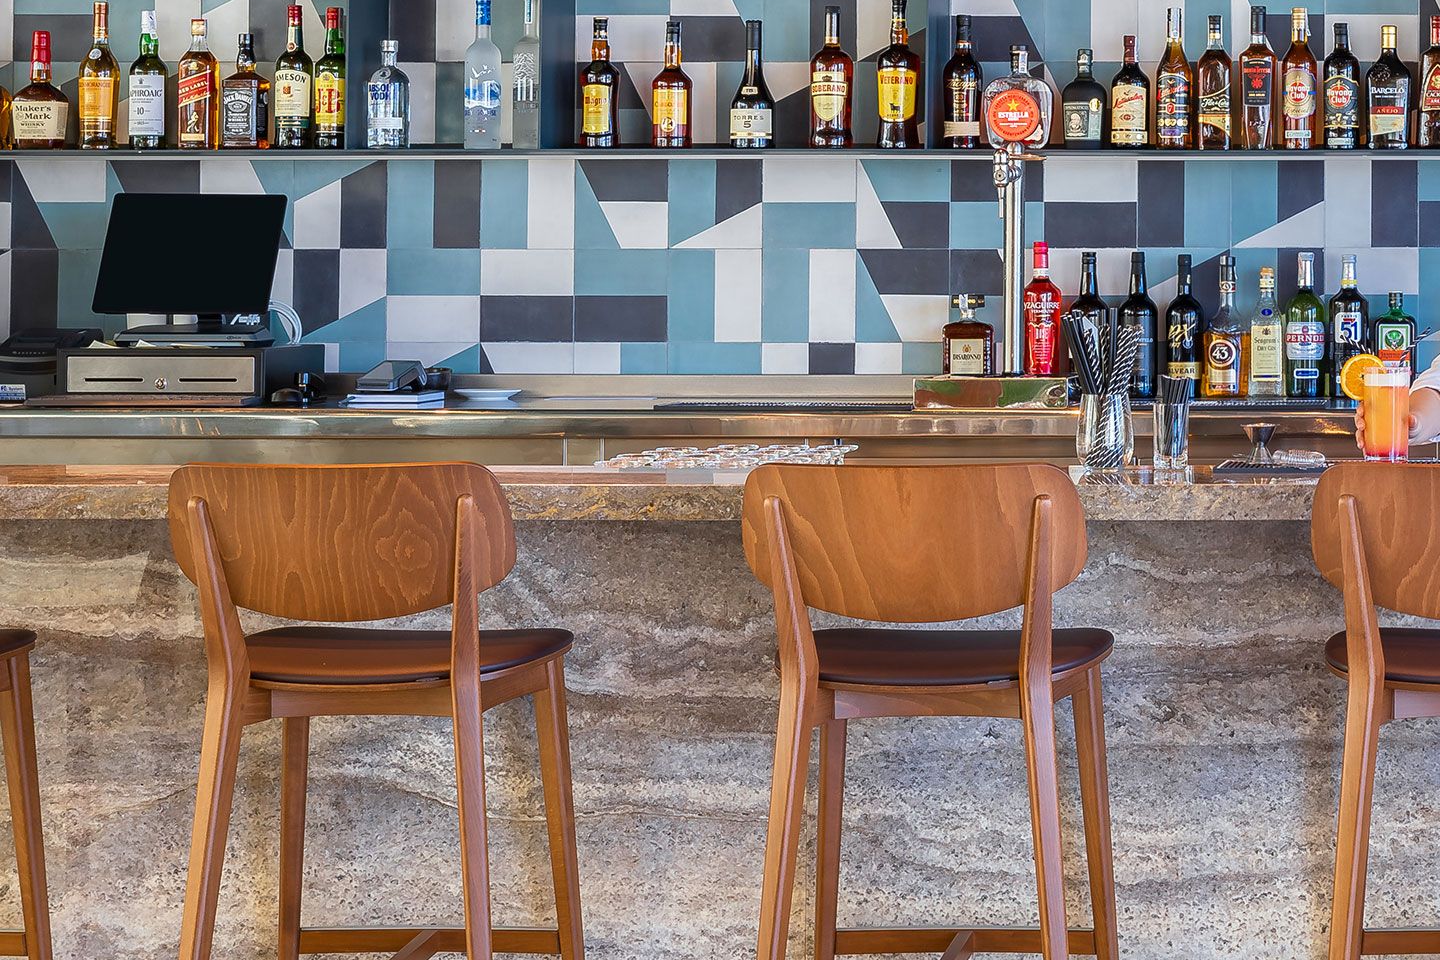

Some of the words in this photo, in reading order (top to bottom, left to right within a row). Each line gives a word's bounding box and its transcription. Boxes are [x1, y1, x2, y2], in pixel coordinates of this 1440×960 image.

[880, 75, 914, 85] VETERANO
[179, 85, 189, 95] RED
[190, 81, 208, 91] LABEL
[811, 84, 846, 94] SOBERANO
[1286, 85, 1310, 94] Havana
[1327, 88, 1352, 97] Havana
[1371, 85, 1404, 94] BARCELÓ
[1291, 91, 1305, 99] Club
[1330, 96, 1345, 104] Club
[15, 105, 52, 113] Maker's
[136, 106, 145, 115] 10
[24, 113, 52, 121] Mark
[743, 120, 752, 128] 5
[1023, 301, 1060, 311] YZAGUIRRE
[1341, 322, 1358, 340] 51
[1286, 334, 1325, 342] PERNOD
[952, 353, 981, 361] DISARONNO
[1212, 346, 1229, 359] 43
